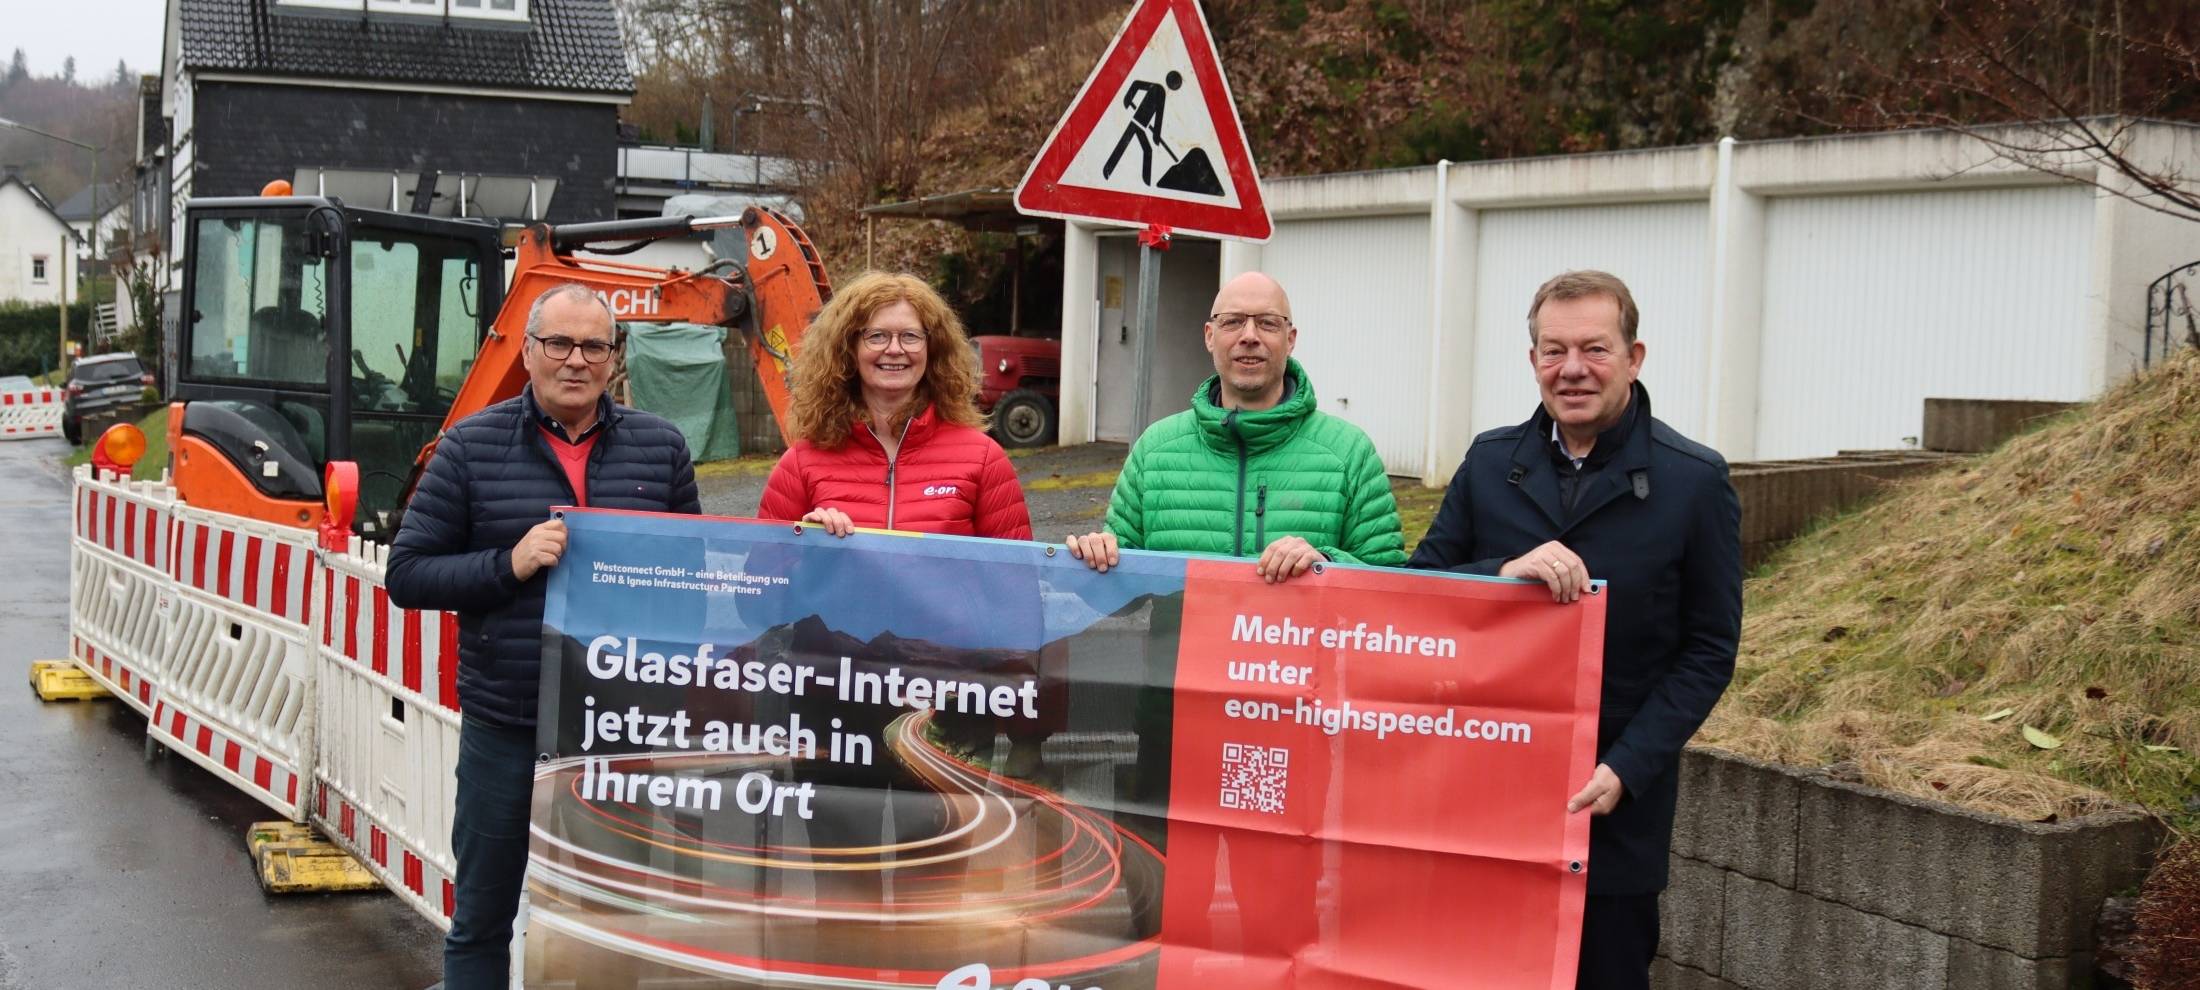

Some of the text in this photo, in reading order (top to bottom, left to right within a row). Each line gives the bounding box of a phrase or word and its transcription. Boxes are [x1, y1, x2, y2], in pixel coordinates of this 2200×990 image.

[757, 233, 770, 255] 1
[592, 573, 762, 595] E.ON & Igneo Infrastructure Partners
[593, 561, 653, 575] Westconnect
[655, 566, 685, 577] GmbH
[695, 570, 714, 580] eine
[716, 570, 770, 585] Beteiligung
[772, 576, 789, 585] von
[1231, 614, 1456, 658] Mehr erfahren
[586, 634, 1038, 720] Glasfaser-Internet
[1227, 660, 1313, 686] unter
[581, 696, 873, 766] jetzt auch in
[1224, 697, 1532, 743] eon-highspeed.com
[582, 757, 816, 820] Ihrem Ort
